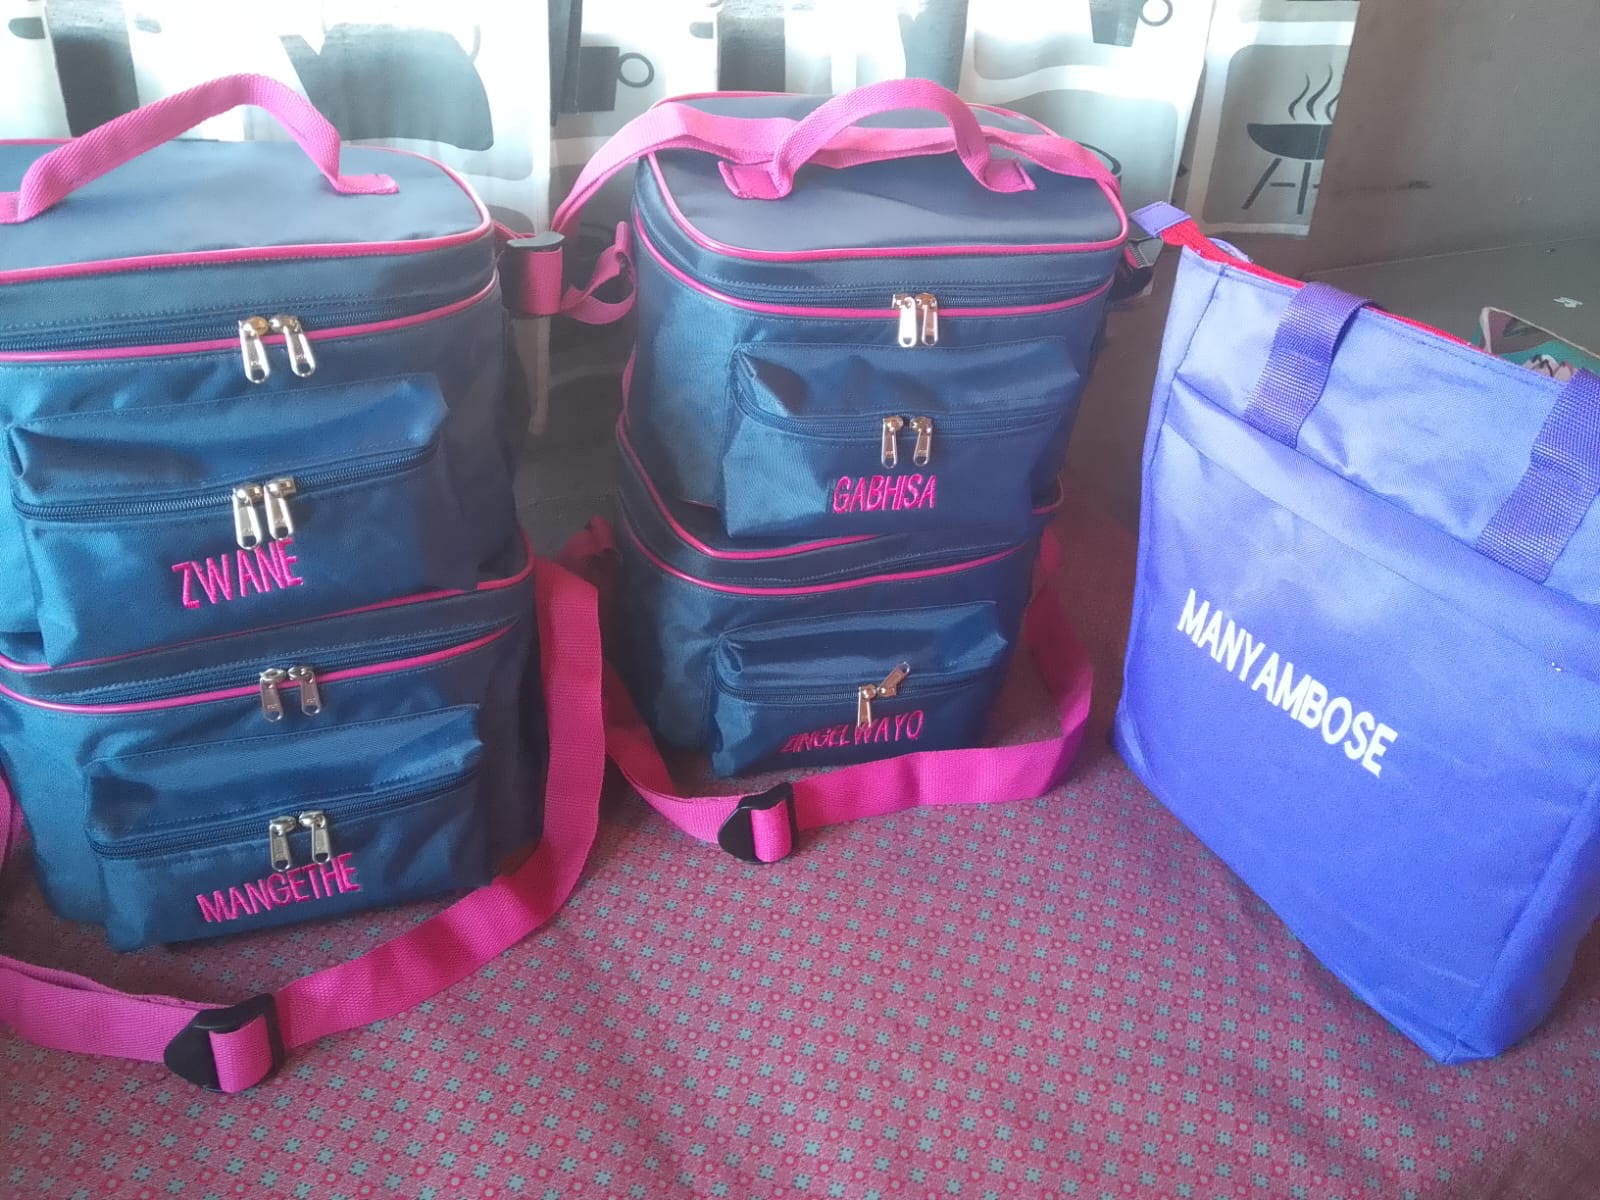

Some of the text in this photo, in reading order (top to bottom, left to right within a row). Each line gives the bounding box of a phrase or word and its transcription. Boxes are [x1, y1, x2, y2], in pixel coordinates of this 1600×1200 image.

[833, 473, 936, 514] GABHISA
[172, 537, 303, 608] ZWANE
[1178, 588, 1398, 777] MANYAMBOSE
[196, 852, 360, 922] MANGETHE
